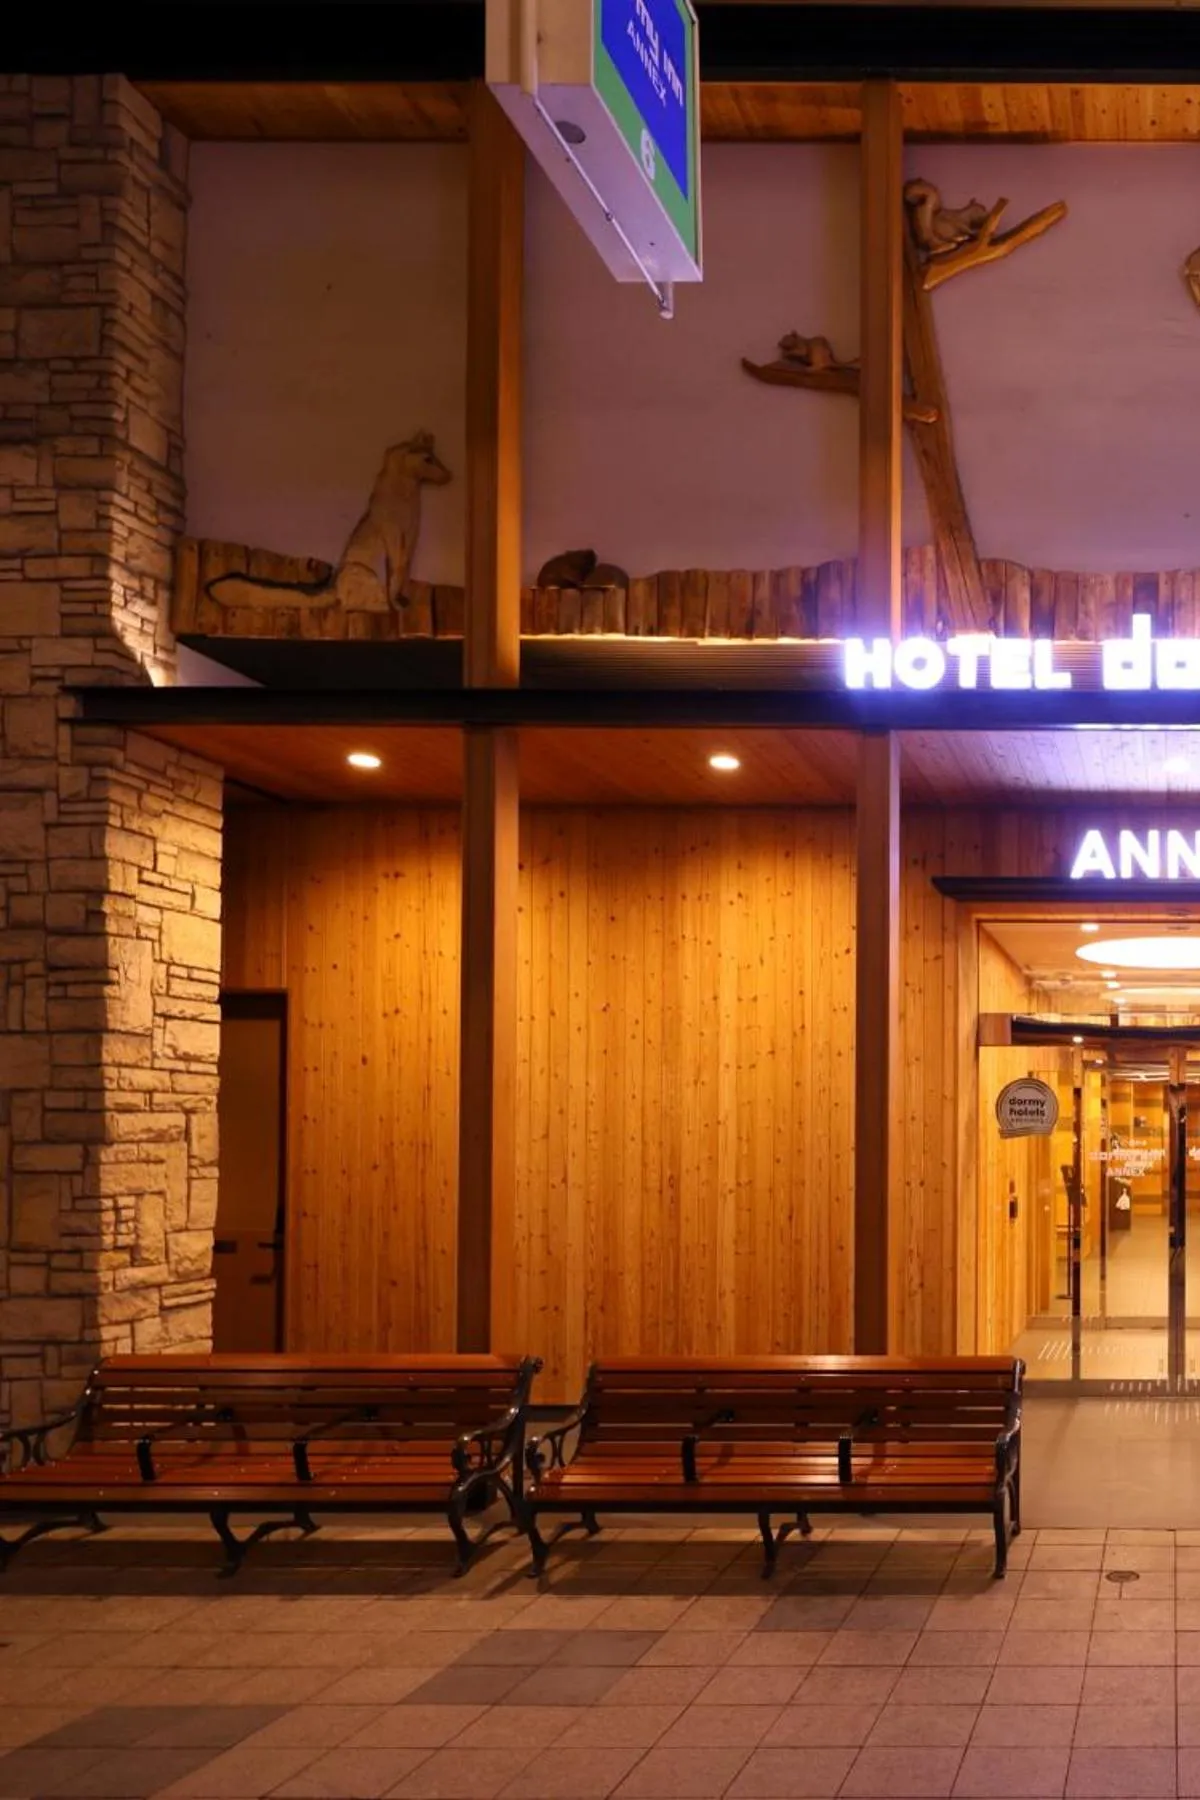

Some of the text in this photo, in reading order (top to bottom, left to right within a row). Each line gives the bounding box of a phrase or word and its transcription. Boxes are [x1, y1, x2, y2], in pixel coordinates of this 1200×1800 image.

[626, 19, 666, 107] ANNEX
[641, 128, 656, 180] 6
[845, 633, 1071, 690] HOTEL
[1009, 1096, 1046, 1108] dormy
[1009, 1107, 1046, 1117] hotels
